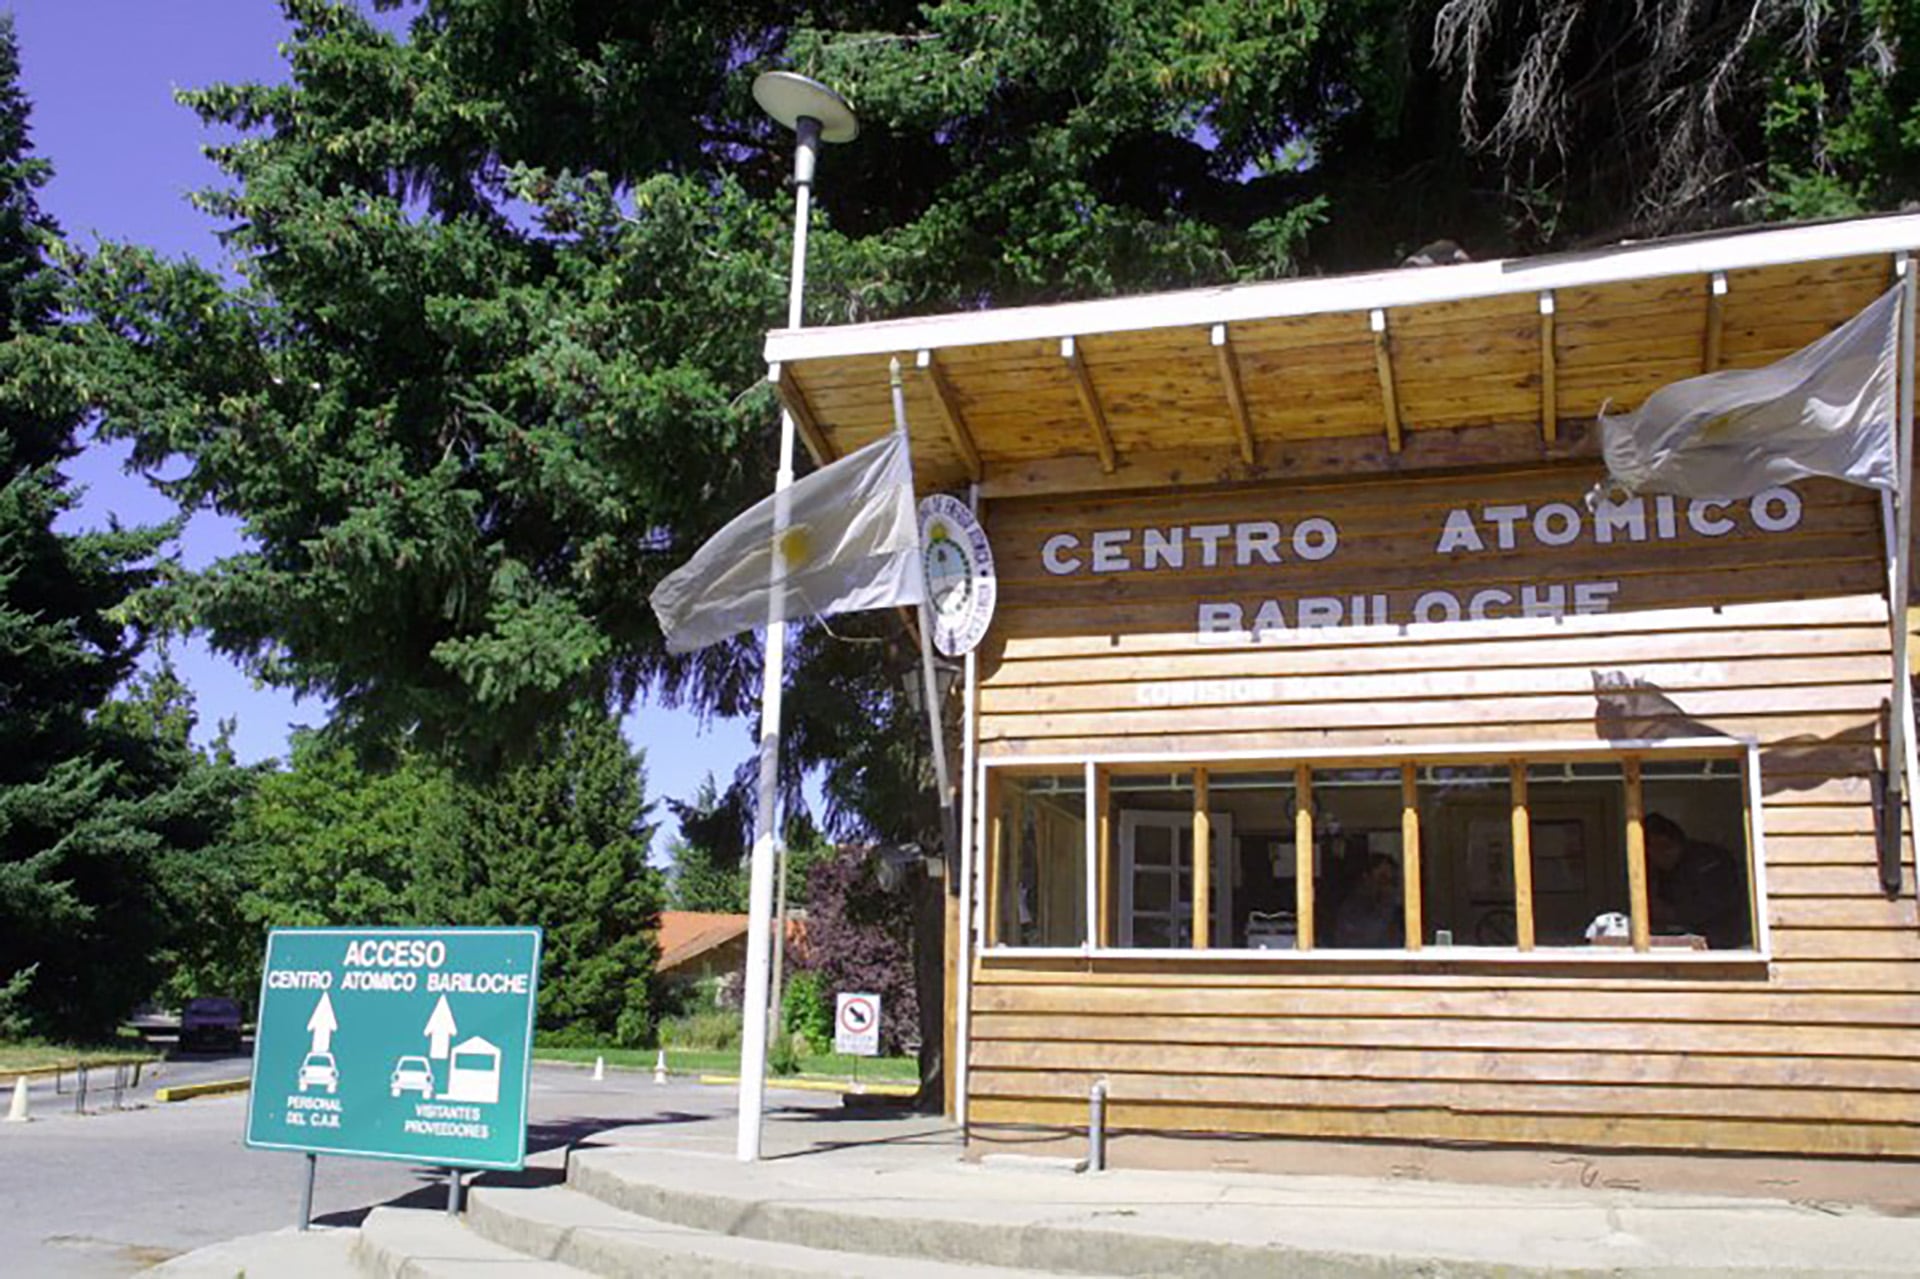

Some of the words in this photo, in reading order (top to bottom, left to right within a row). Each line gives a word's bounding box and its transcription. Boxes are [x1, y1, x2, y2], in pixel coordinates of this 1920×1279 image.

[1041, 517, 1339, 576] CENTRO
[1436, 487, 1802, 554] ATOMICO
[1198, 580, 1620, 643] BARILOCHE
[343, 940, 446, 968] ACCESO
[268, 970, 333, 990] CENTRO
[341, 971, 417, 992] ATOMICO
[427, 973, 529, 995] BARILOCHE
[287, 1095, 343, 1113] PERSONAL
[415, 1103, 481, 1121] VISITANTES
[286, 1111, 307, 1126] DEL
[404, 1119, 489, 1139] PROVEEDORES
